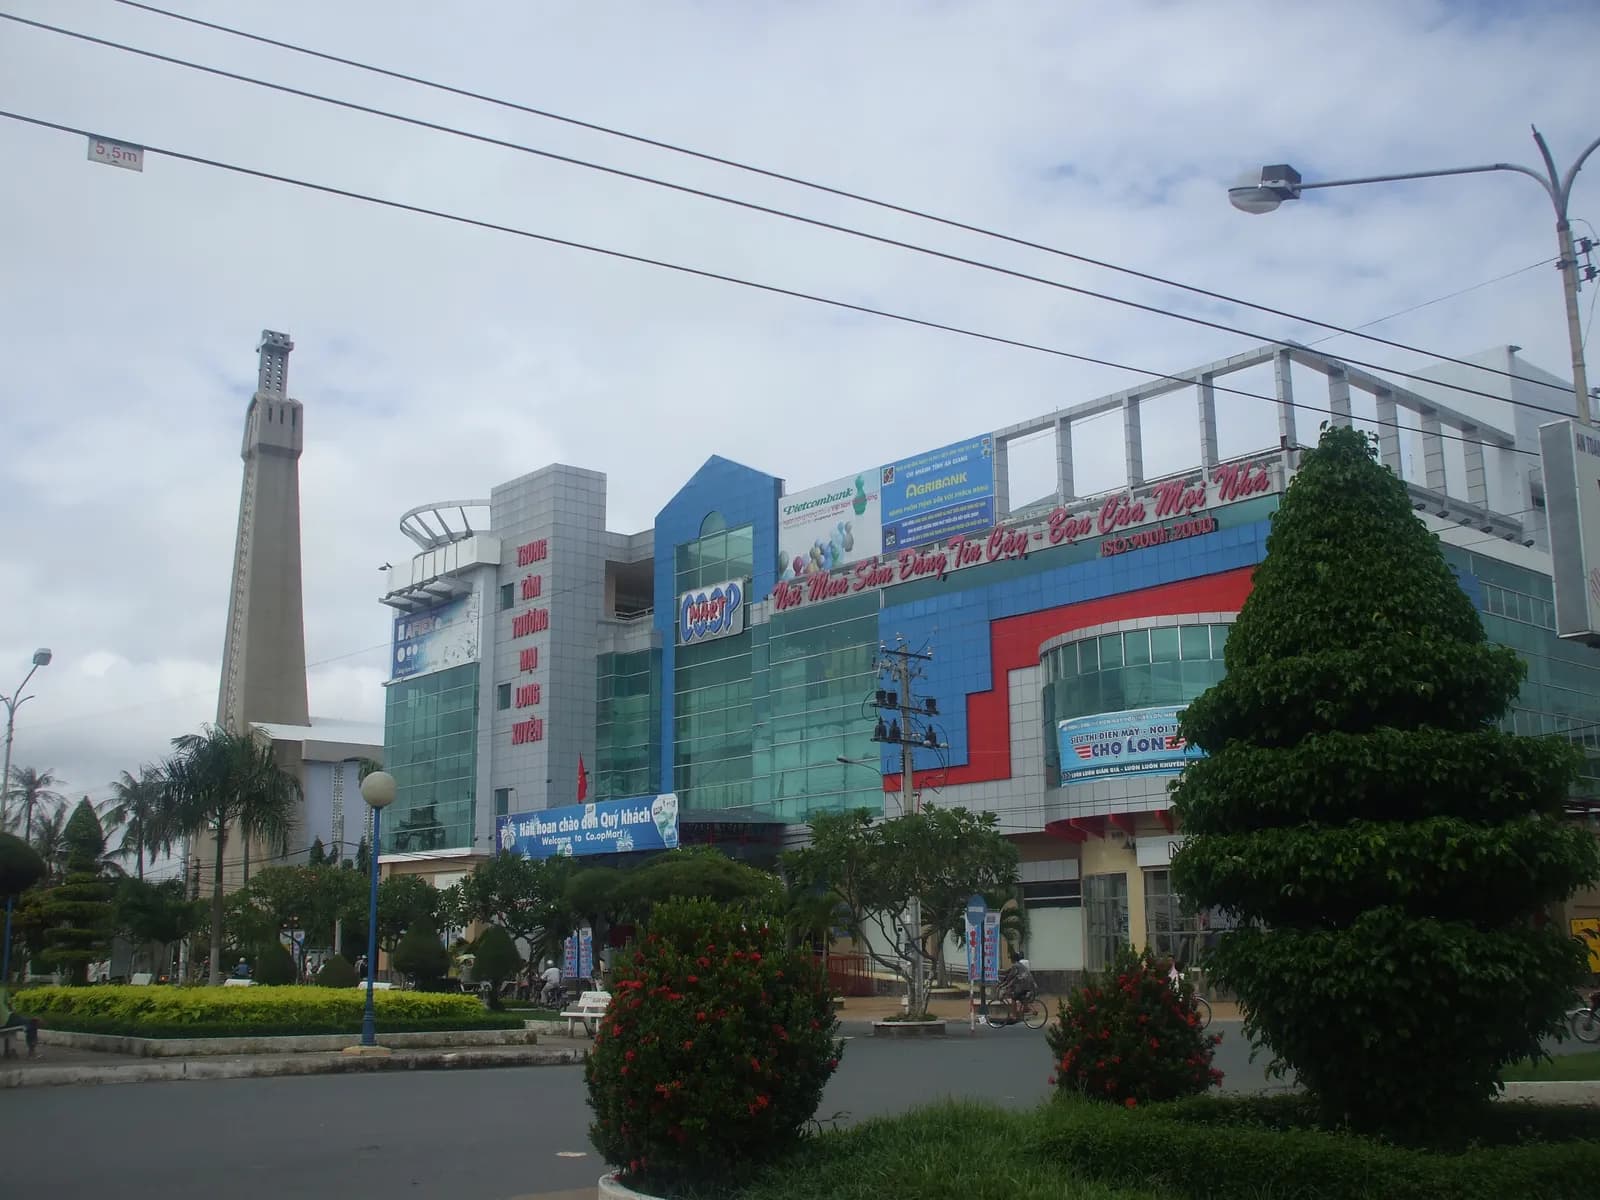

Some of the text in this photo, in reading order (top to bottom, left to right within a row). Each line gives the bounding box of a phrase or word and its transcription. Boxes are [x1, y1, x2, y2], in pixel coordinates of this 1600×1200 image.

[96, 140, 137, 162] 5.5m
[906, 472, 968, 499] AGRIBANK
[517, 539, 547, 567] TRUNG
[1102, 537, 1128, 557] ISO
[807, 569, 848, 602] Mua
[948, 534, 982, 568] Tin
[521, 573, 541, 601] TÂM
[520, 647, 538, 675] MẠI
[515, 683, 540, 709] LONG
[512, 715, 543, 745] XUYÊN
[558, 816, 579, 832] chào
[601, 810, 618, 829] Quý
[621, 807, 650, 824] khách
[541, 829, 623, 846] Welcome to Co.opMart
